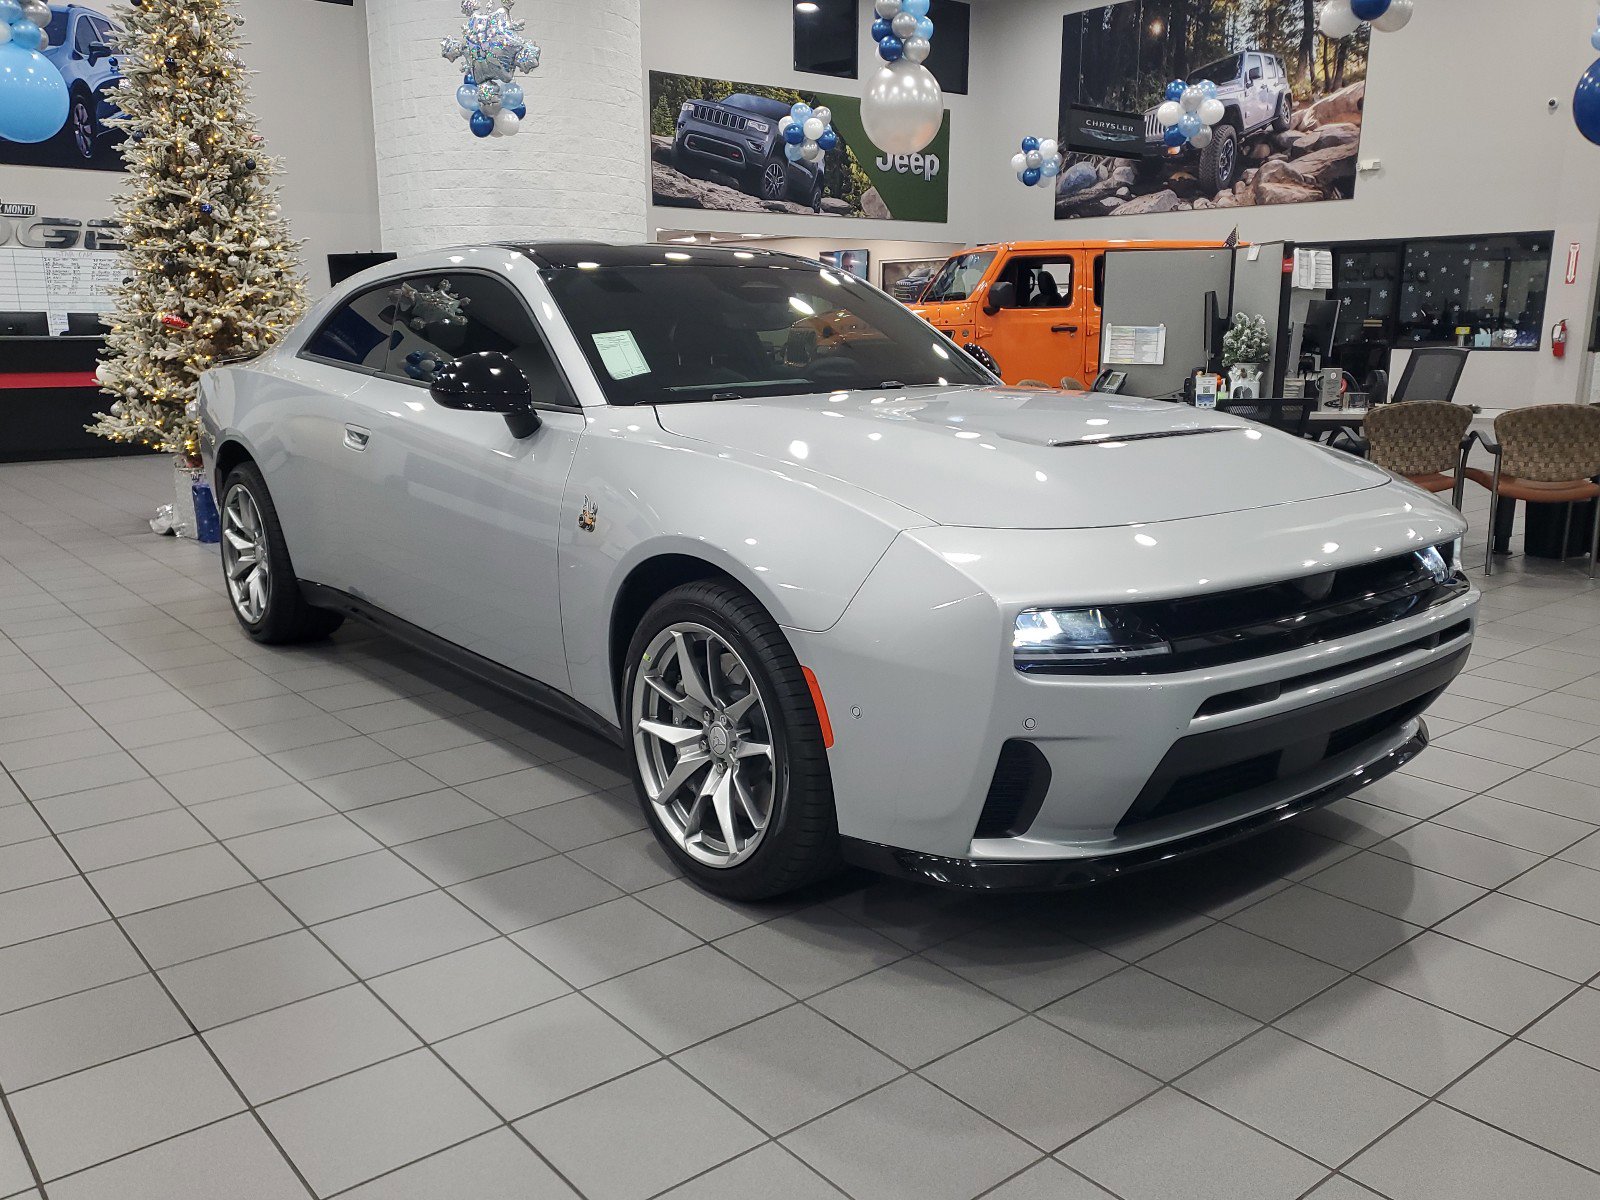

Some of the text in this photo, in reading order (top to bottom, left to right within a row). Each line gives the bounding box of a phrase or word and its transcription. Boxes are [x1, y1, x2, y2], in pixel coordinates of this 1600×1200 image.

[1085, 119, 1134, 132] CHRYSLER
[875, 152, 940, 182] Jeep
[4, 204, 34, 215] MONTH
[0, 216, 127, 250] GE
